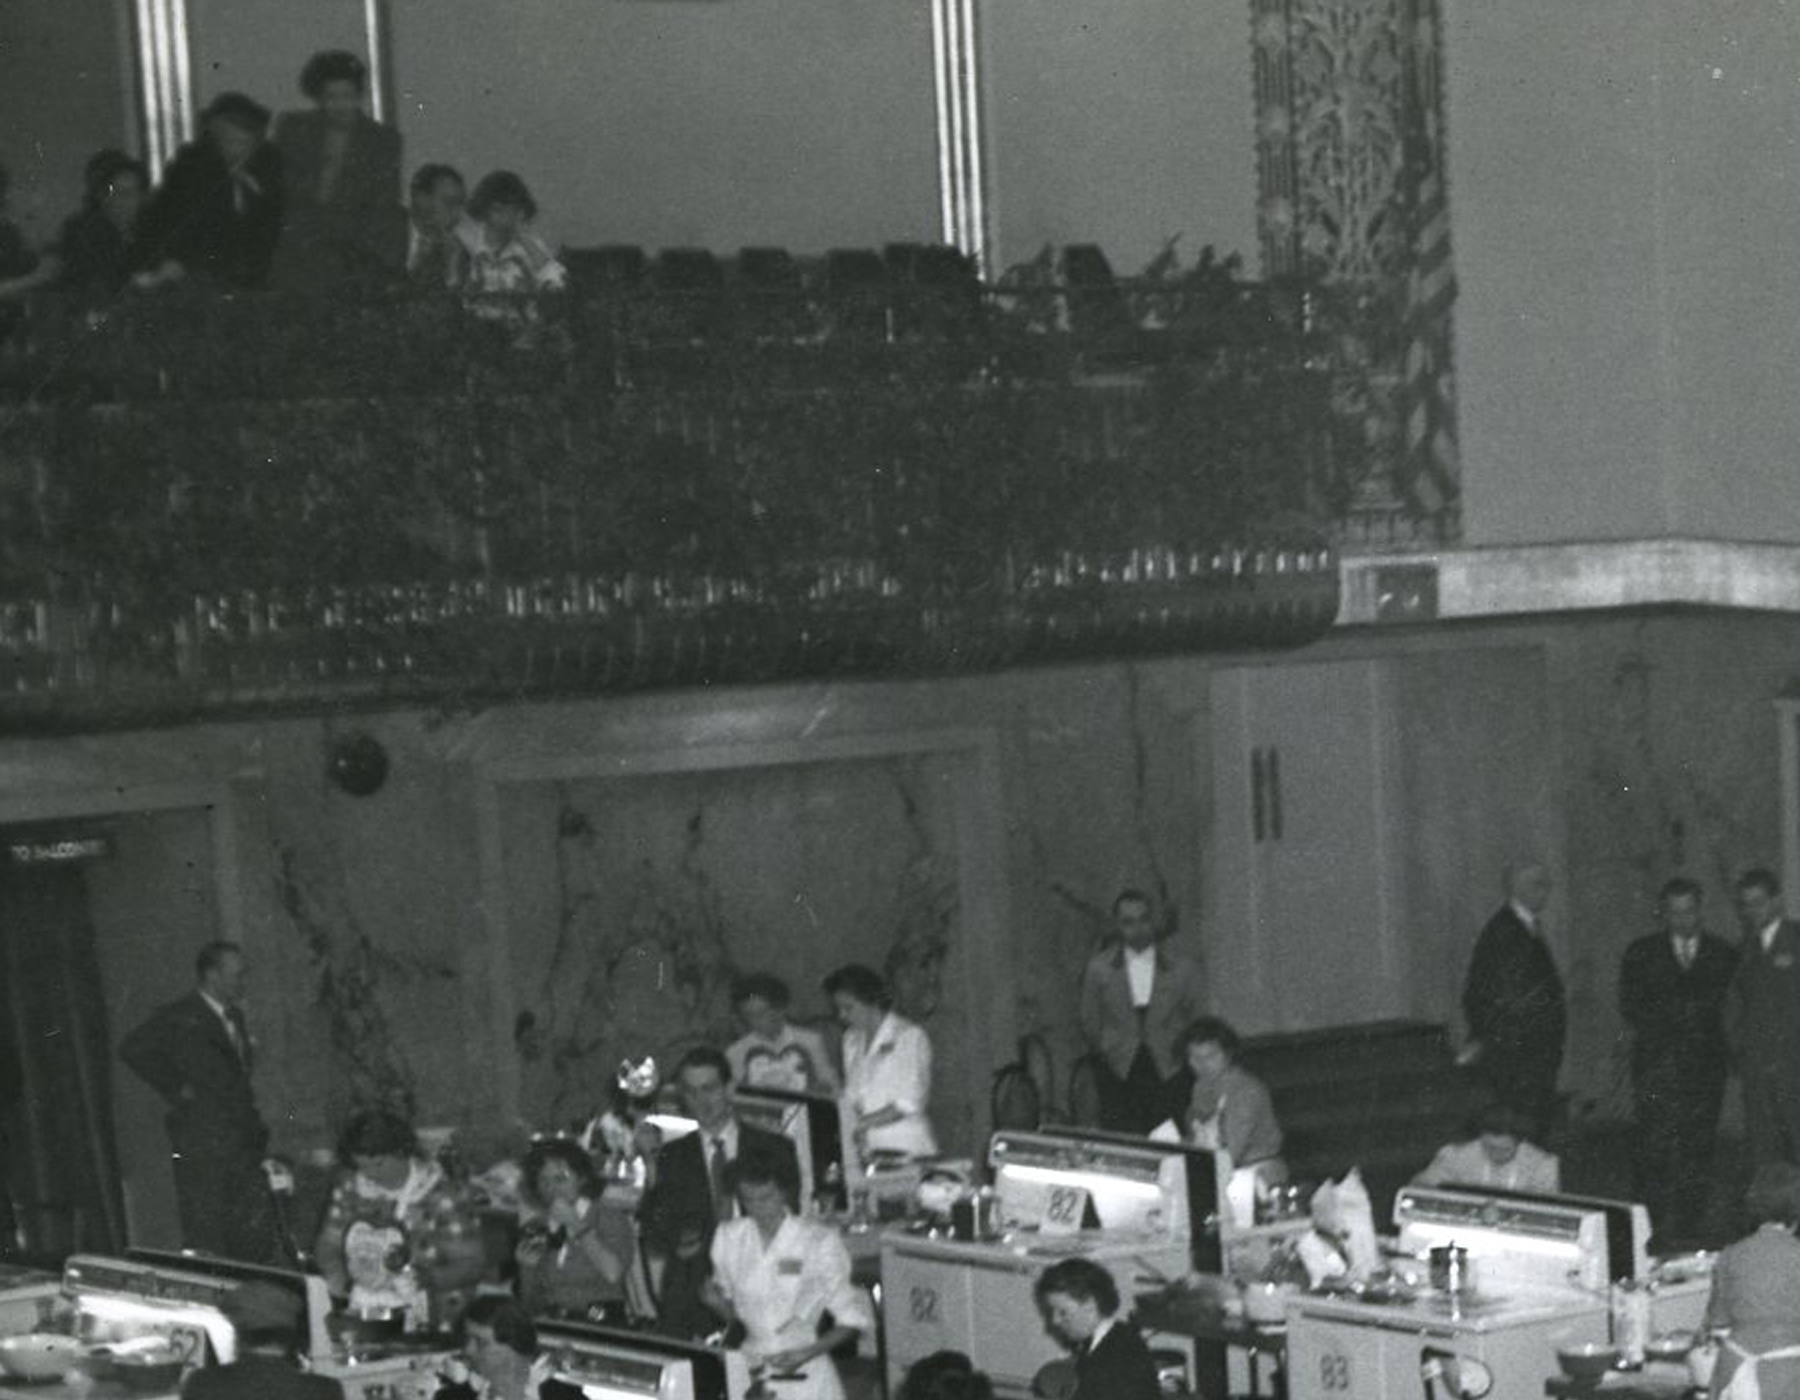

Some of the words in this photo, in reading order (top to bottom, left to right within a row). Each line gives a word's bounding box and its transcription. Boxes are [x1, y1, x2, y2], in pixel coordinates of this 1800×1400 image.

[1048, 1189, 1078, 1225] 82
[909, 1286, 940, 1323] 82
[1319, 1353, 1350, 1392] 83
